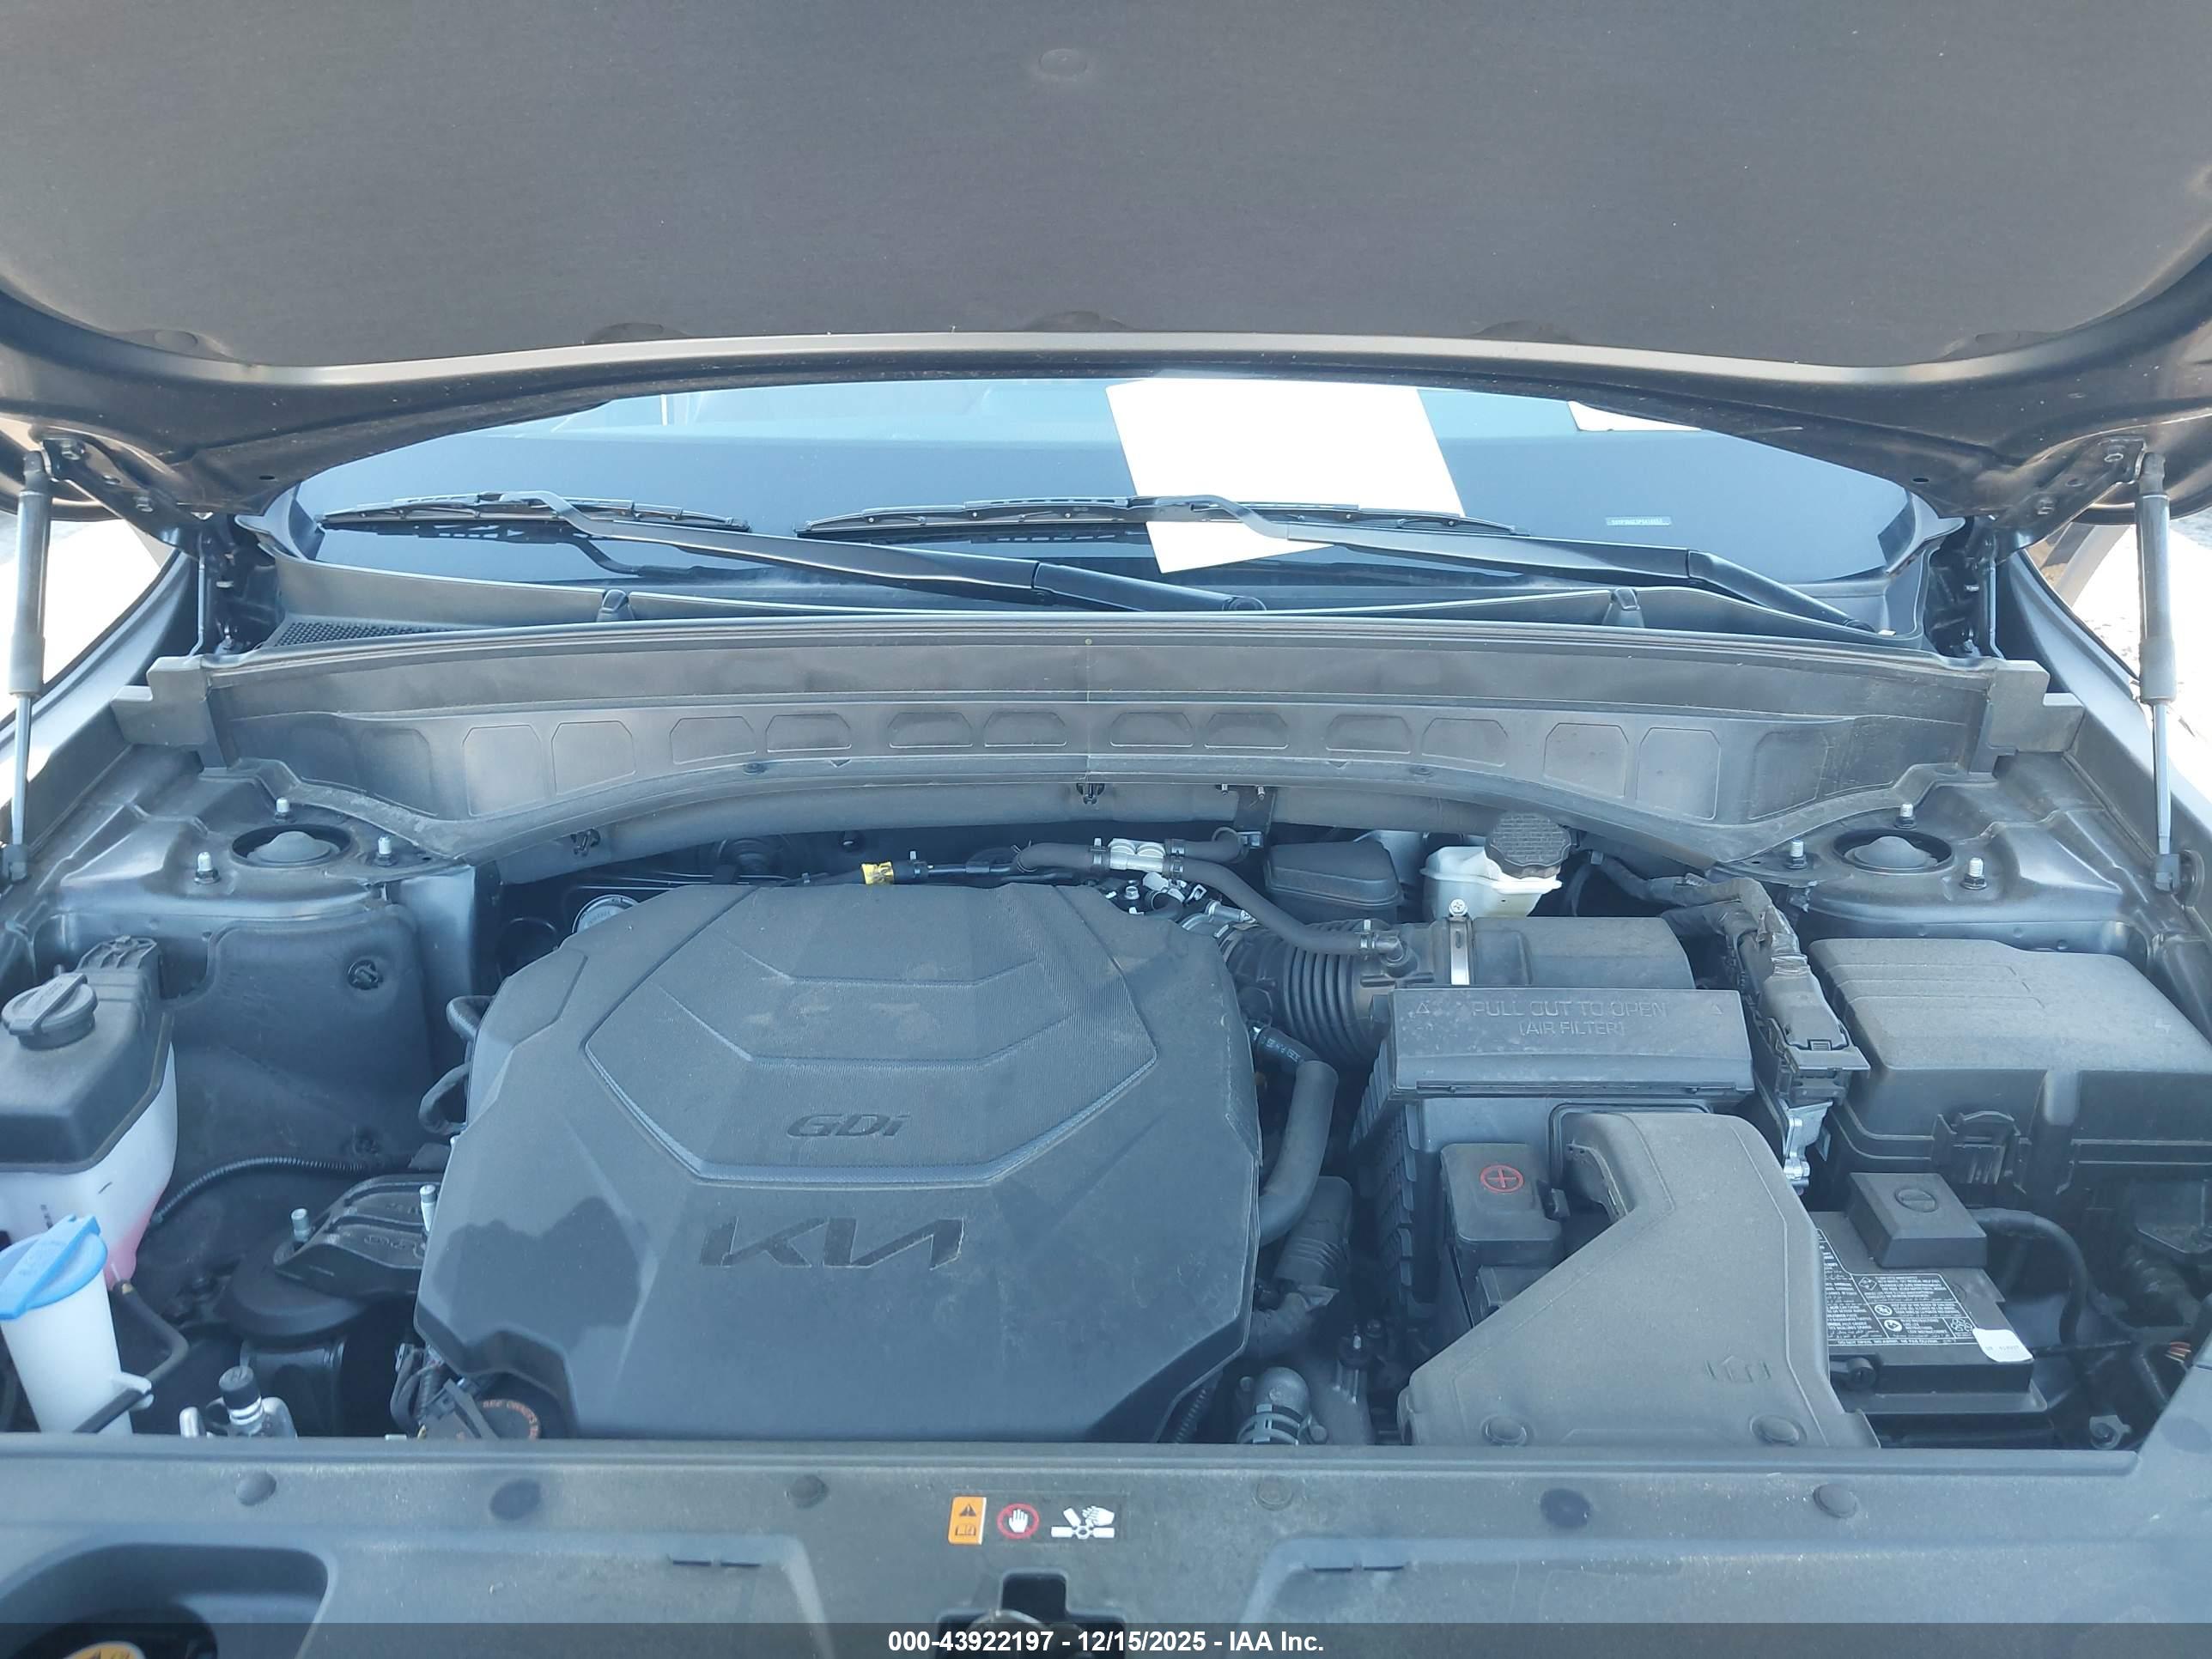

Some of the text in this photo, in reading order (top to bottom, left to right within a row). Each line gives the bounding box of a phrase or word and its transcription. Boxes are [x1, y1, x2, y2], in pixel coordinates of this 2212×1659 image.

[1471, 1000, 1668, 1018] PULL OUT TO OPEN
[1518, 1021, 1625, 1036] (AIR FILTER)
[787, 1114, 912, 1139] GDi
[699, 1216, 966, 1271] KIA
